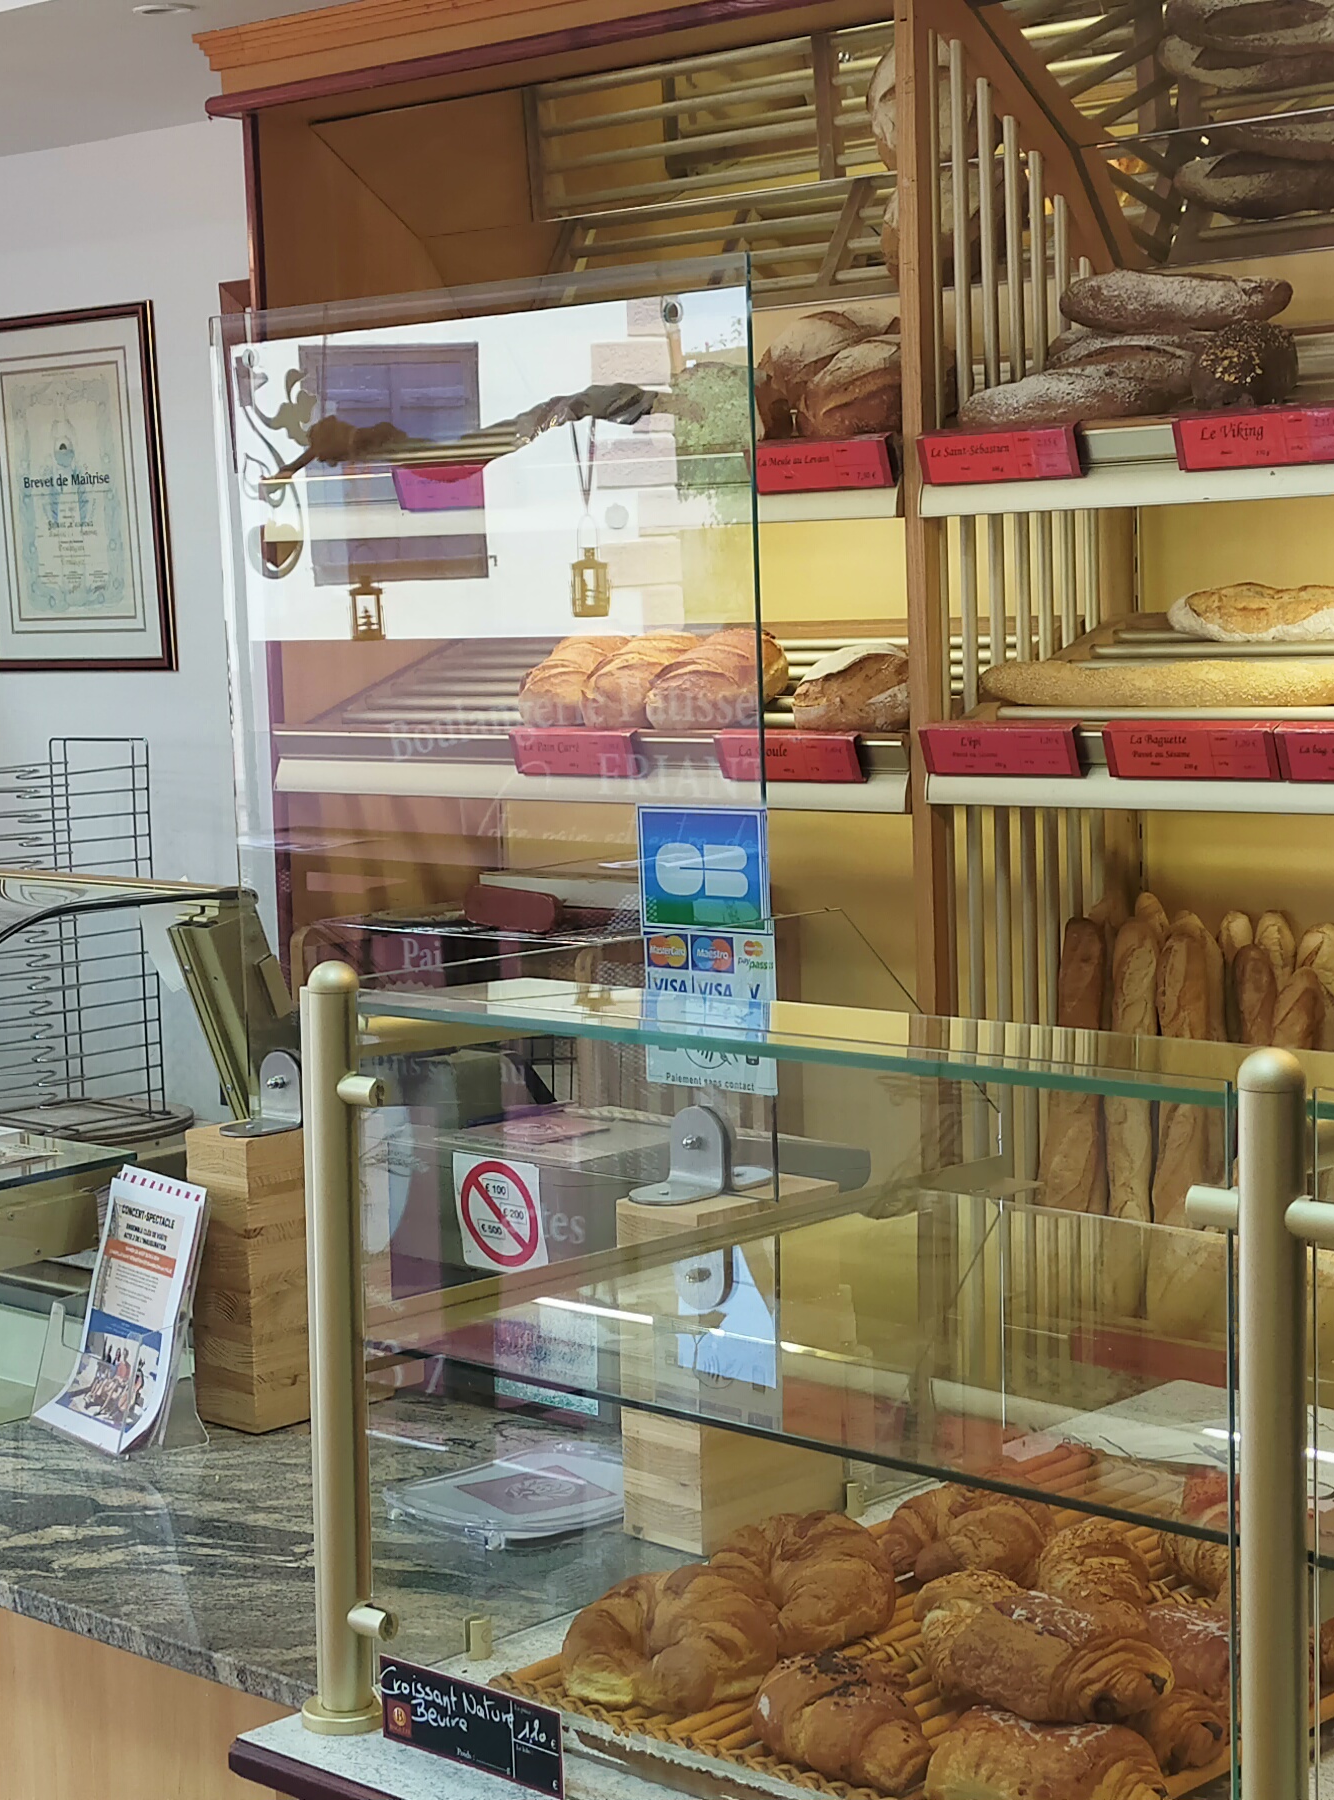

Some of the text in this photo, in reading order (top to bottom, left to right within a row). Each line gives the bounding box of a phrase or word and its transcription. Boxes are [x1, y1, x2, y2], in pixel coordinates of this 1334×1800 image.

[1200, 421, 1264, 441] Le Viking
[931, 447, 942, 458] Le
[23, 471, 110, 489] Brevet de Maîtrise
[1129, 734, 1187, 748] La Baguette
[738, 743, 788, 757] La oule
[648, 944, 687, 957] MasterCard
[696, 947, 729, 960] Maestro
[653, 976, 688, 994] VISA
[697, 981, 733, 998] VISA
[665, 1072, 702, 1086] Paiement
[724, 1079, 755, 1092] contact
[492, 1184, 507, 1196] 100
[509, 1209, 525, 1221] 200
[487, 1225, 503, 1236] 500
[380, 1665, 515, 1729] Croissant Nature
[550, 1738, 557, 1750] €
[552, 1780, 558, 1791] €
